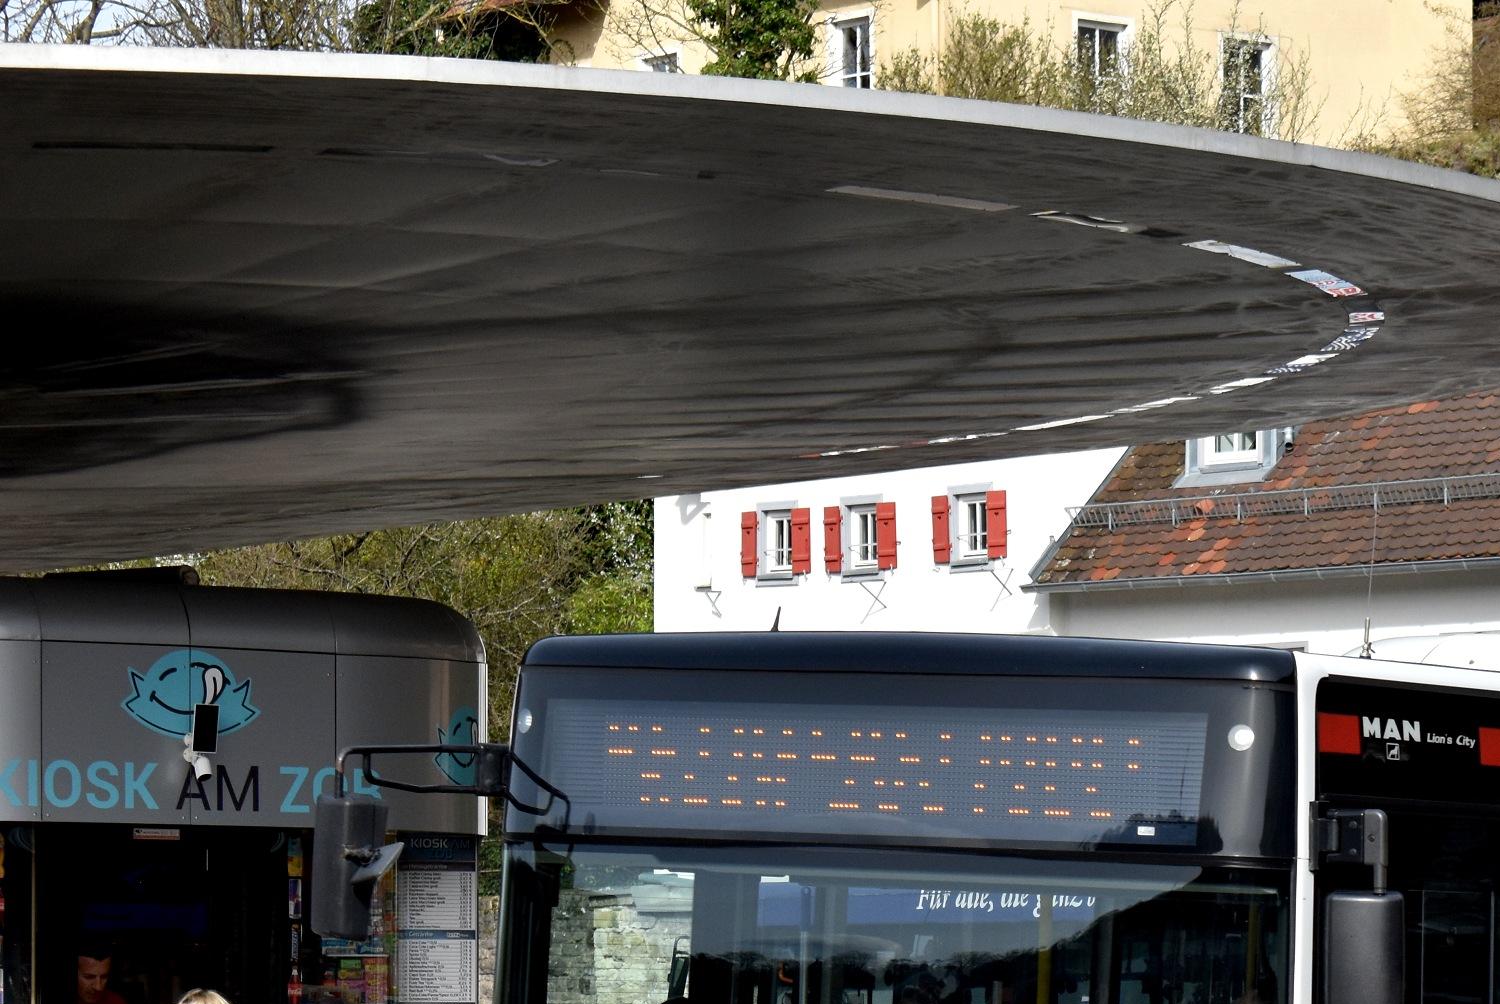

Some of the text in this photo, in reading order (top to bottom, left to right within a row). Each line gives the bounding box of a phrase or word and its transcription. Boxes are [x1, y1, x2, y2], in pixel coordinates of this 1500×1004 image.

[1362, 716, 1476, 748] MAN Lion's City
[0, 758, 159, 811] KIOSK
[175, 764, 260, 812] AM
[410, 838, 449, 849] KIOSK
